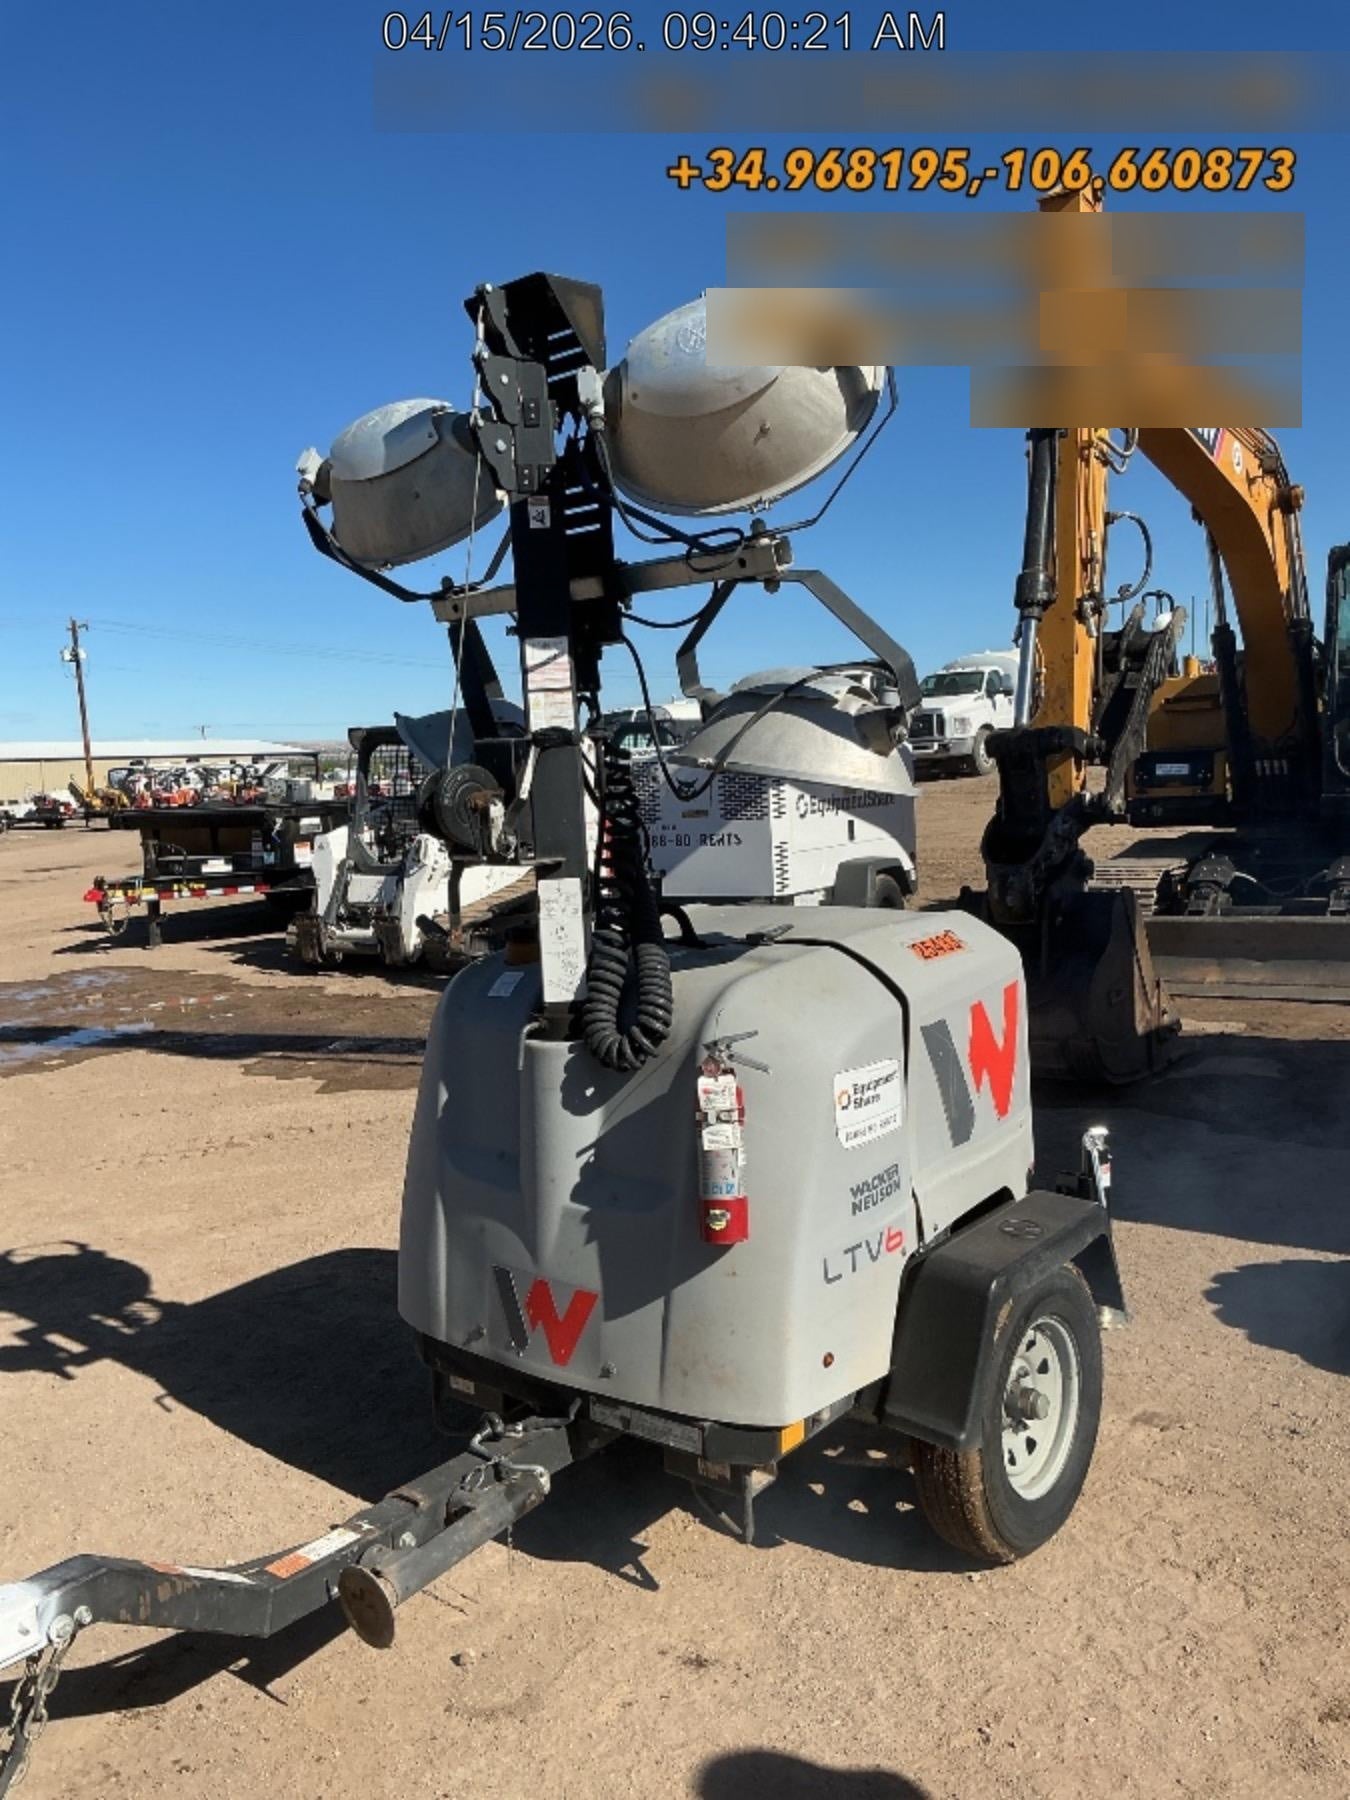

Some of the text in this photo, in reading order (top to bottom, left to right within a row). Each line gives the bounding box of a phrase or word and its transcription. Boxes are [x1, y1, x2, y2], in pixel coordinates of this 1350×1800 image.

[849, 1163, 899, 1200] WACKER
[851, 1176, 900, 1217] NEUSON
[823, 1226, 904, 1285] LTV6
